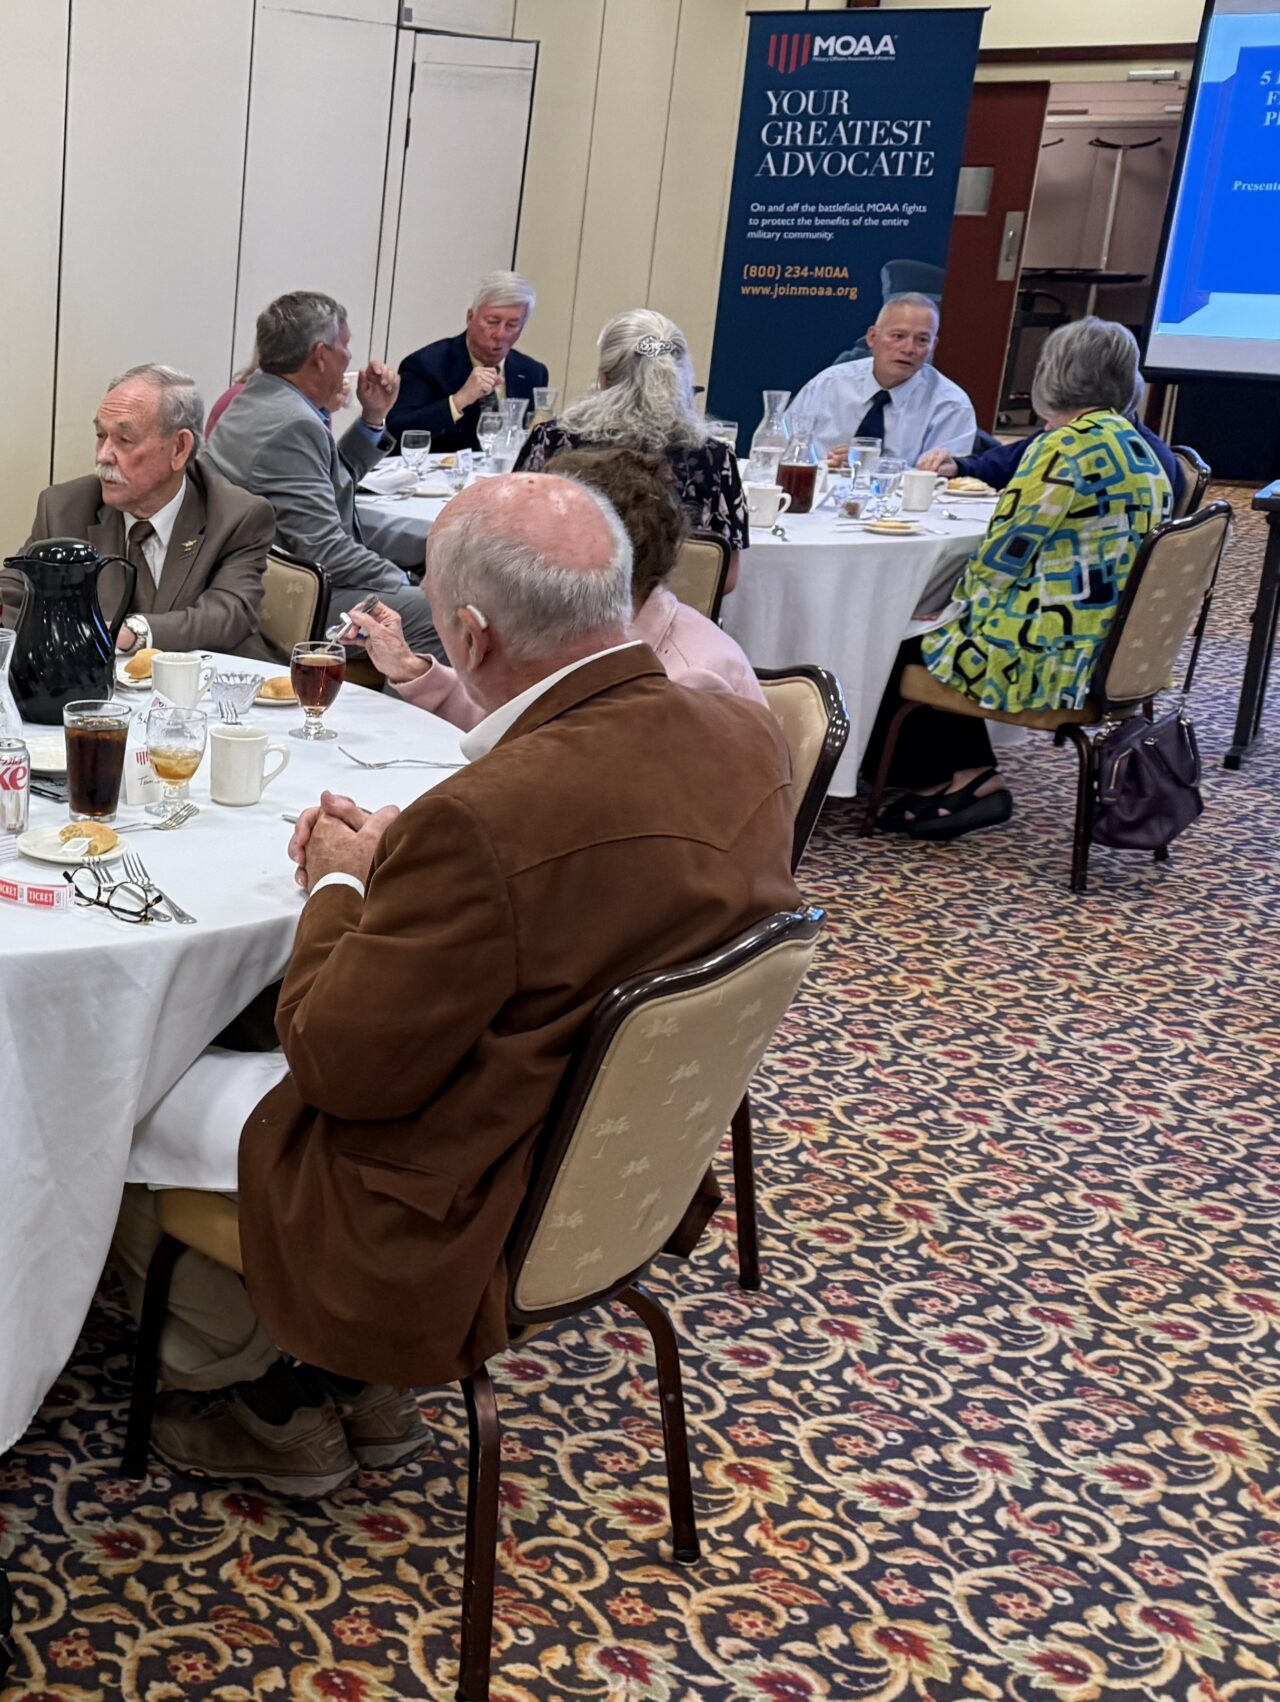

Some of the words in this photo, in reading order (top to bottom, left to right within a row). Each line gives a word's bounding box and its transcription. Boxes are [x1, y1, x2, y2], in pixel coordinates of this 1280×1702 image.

[813, 34, 896, 56] MOAA
[1260, 70, 1272, 85] 5
[765, 89, 851, 116] YOUR
[1266, 90, 1280, 105] F
[761, 119, 931, 147] GREATEST
[754, 150, 935, 177] ADVOCATE
[750, 202, 766, 212] On
[767, 203, 785, 212] and
[786, 203, 800, 212] off
[801, 203, 816, 212] the
[818, 203, 865, 213] battlefield,
[866, 203, 899, 212] MOAA
[901, 203, 927, 215] fights
[748, 218, 760, 226] to
[760, 217, 795, 228] protect
[797, 216, 812, 226] the
[814, 216, 850, 226] benefits
[852, 216, 863, 226] of
[863, 216, 880, 226] the
[881, 217, 909, 226] entire
[747, 230, 781, 241] military
[782, 231, 835, 241] community.
[743, 264, 781, 280] (800)
[784, 265, 849, 278] 234-MOAA
[741, 283, 858, 300] www.joinmoaa.org
[28, 890, 53, 904] TICKET
